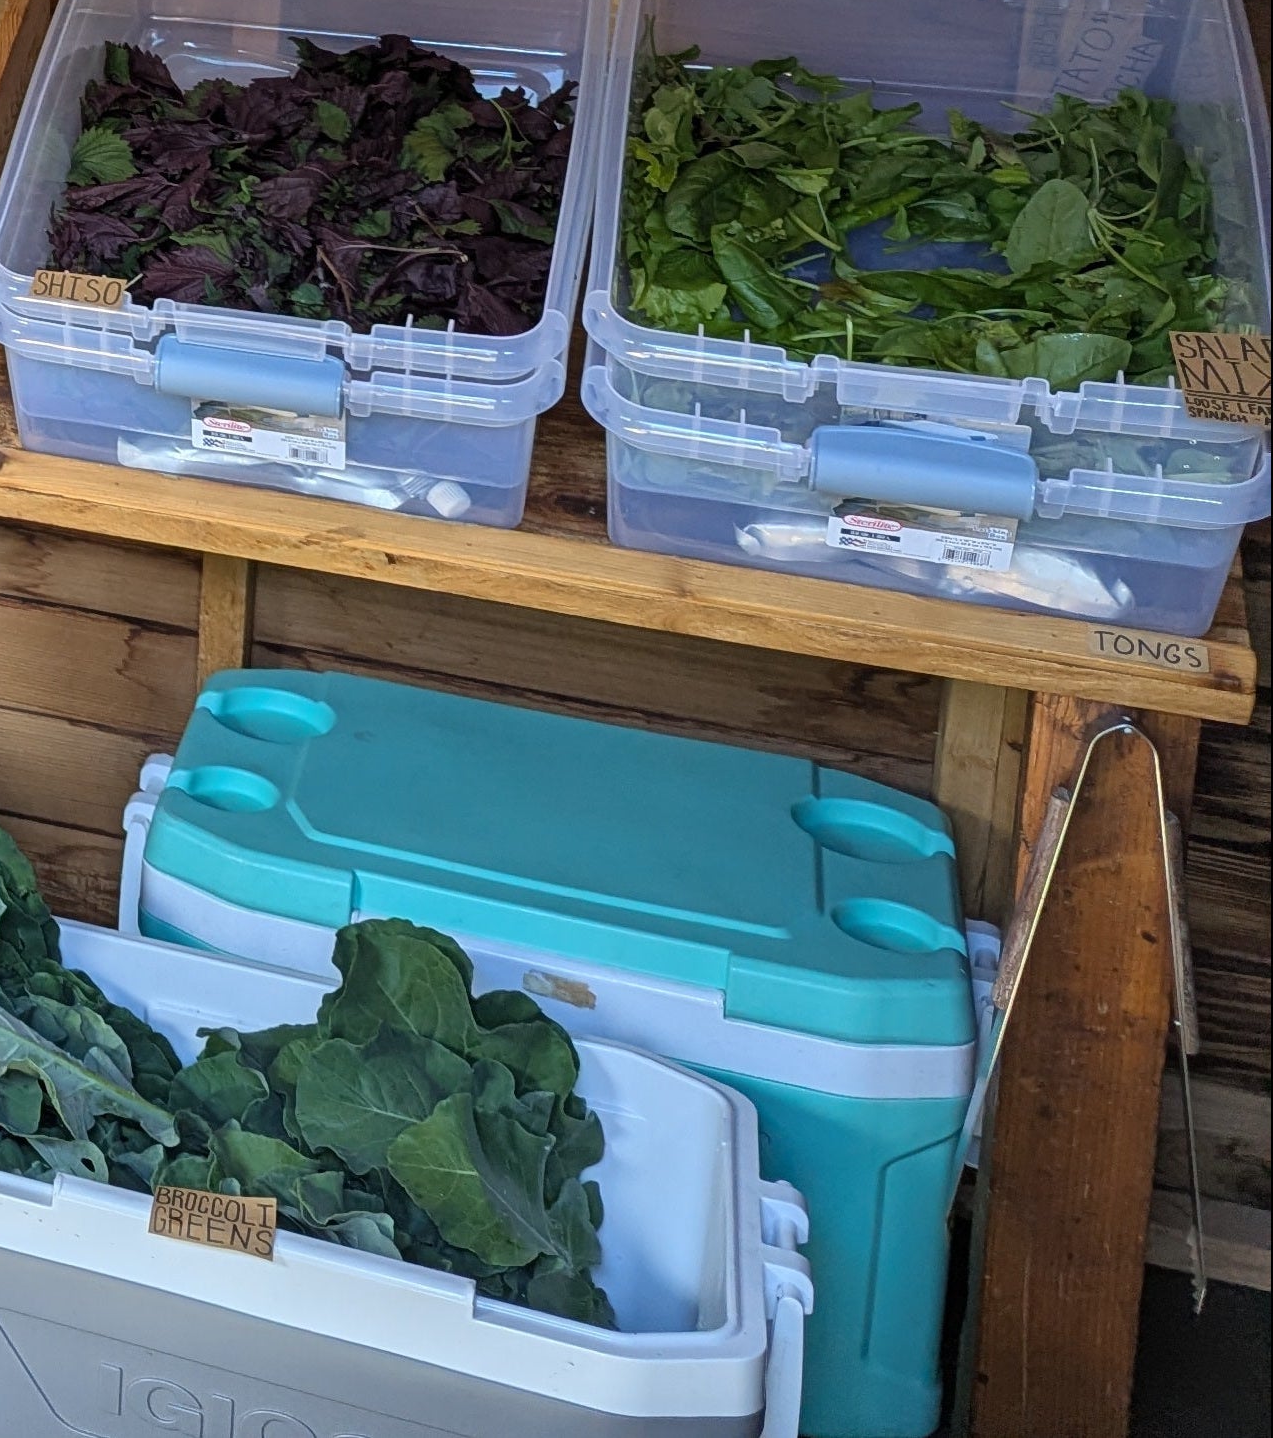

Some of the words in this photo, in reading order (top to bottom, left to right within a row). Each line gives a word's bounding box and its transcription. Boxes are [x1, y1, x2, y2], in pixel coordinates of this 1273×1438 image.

[36, 271, 124, 306] SHISO
[1185, 396, 1231, 412] LOOSE
[1094, 630, 1202, 668] TONGS
[155, 1186, 274, 1229] BROCCOLI
[153, 1205, 274, 1256] GREENS
